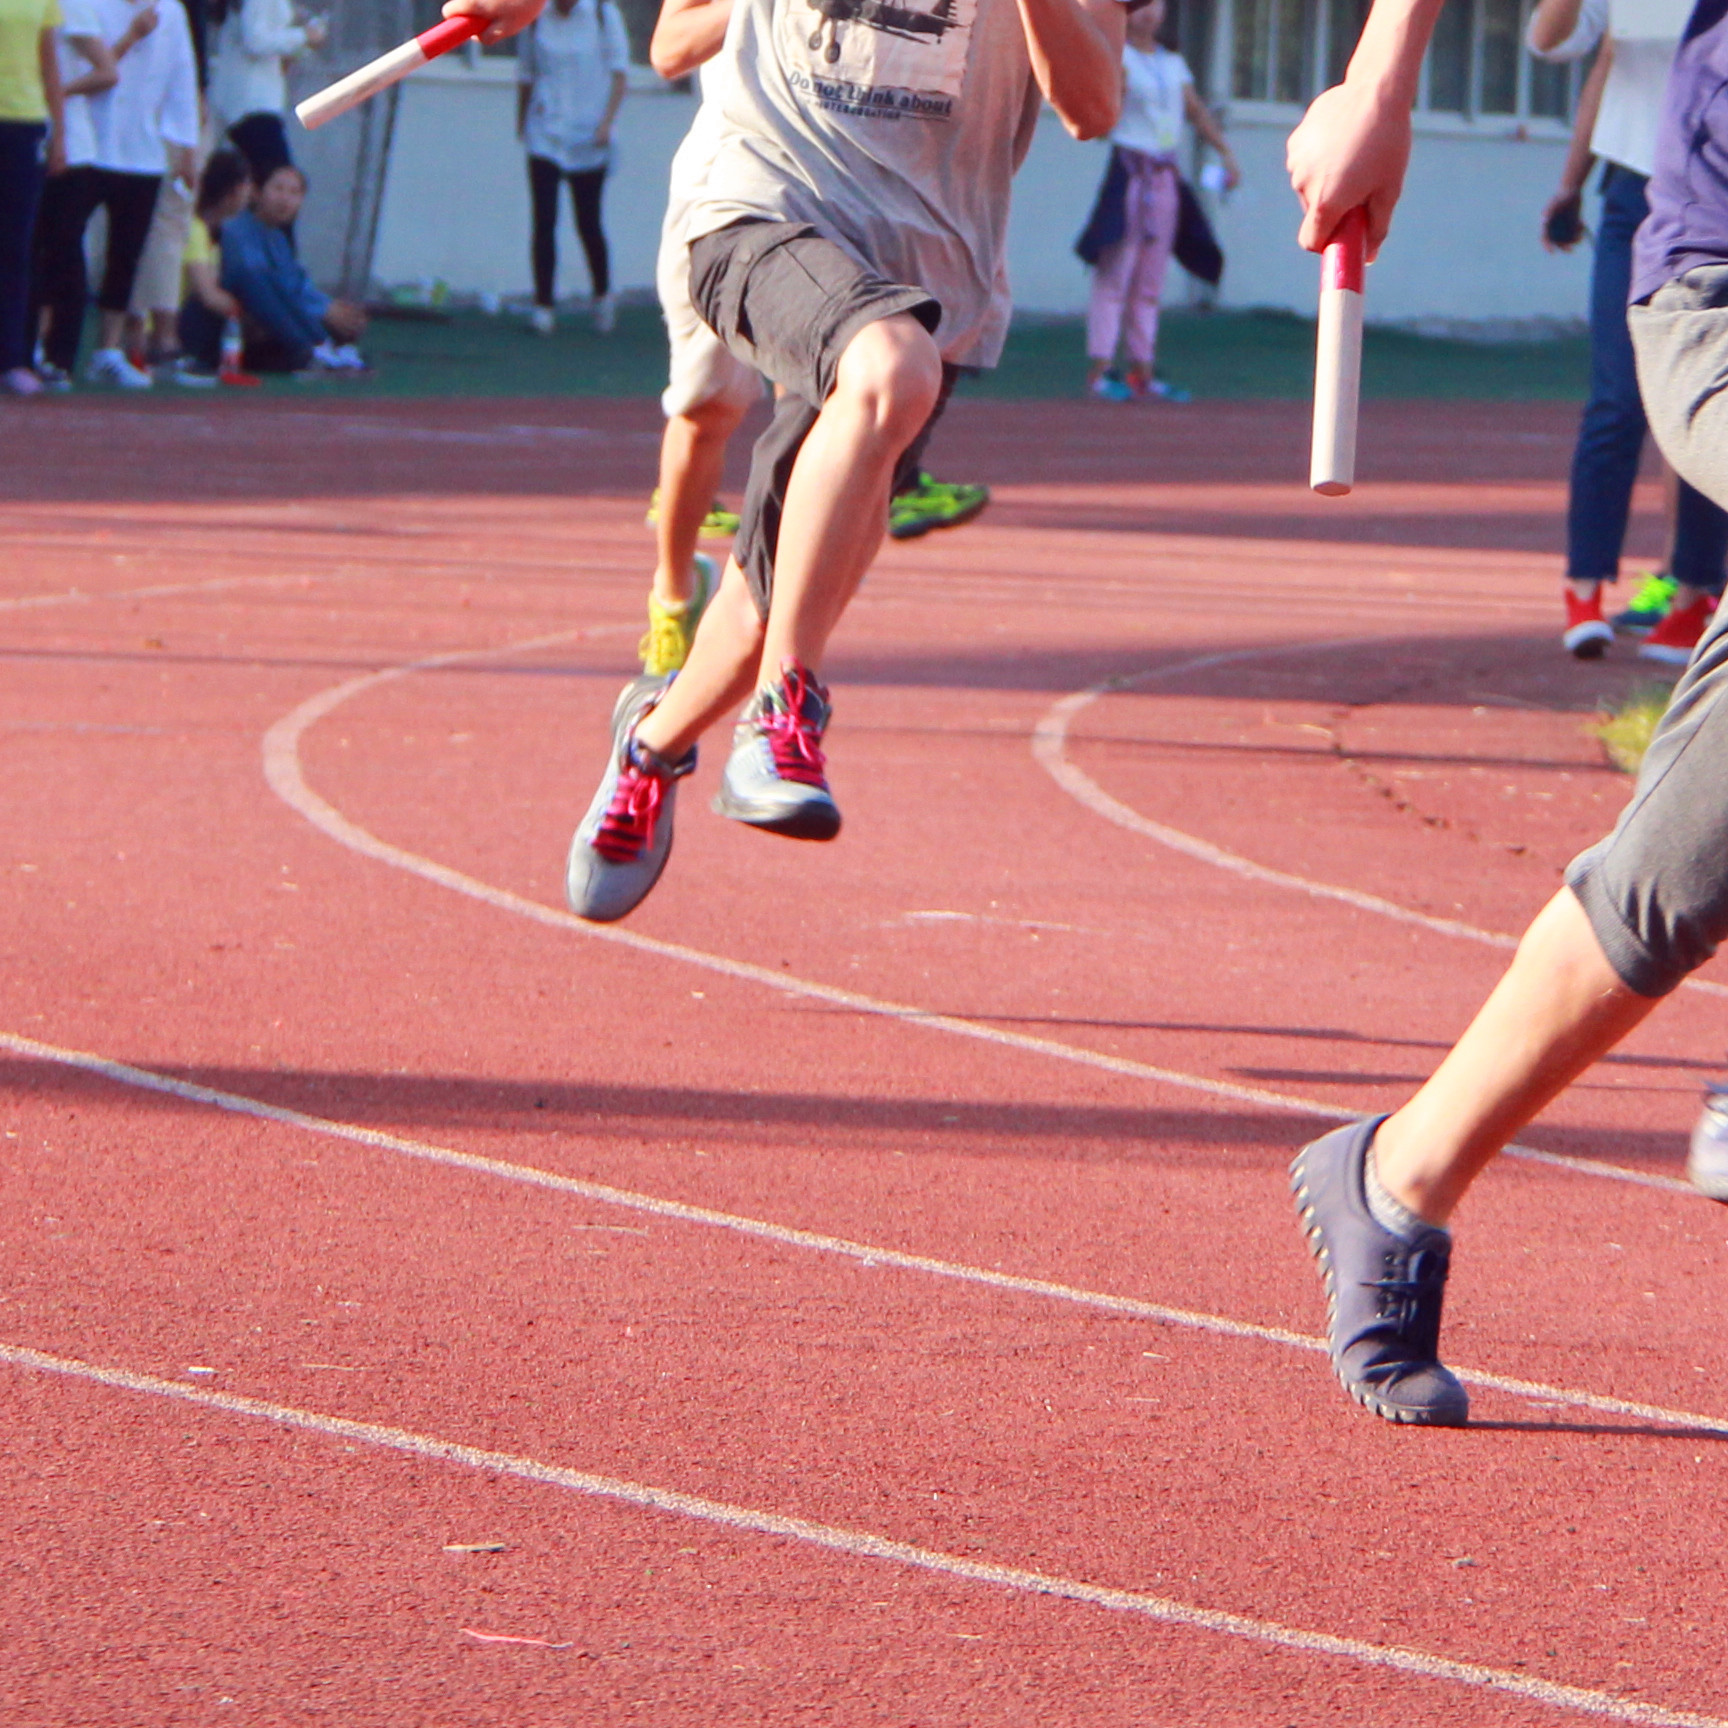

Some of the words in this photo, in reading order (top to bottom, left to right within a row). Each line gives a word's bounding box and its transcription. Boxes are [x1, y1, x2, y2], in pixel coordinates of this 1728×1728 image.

[788, 70, 810, 89] Do
[812, 79, 842, 99] not
[848, 82, 895, 106] think
[899, 91, 953, 114] about
